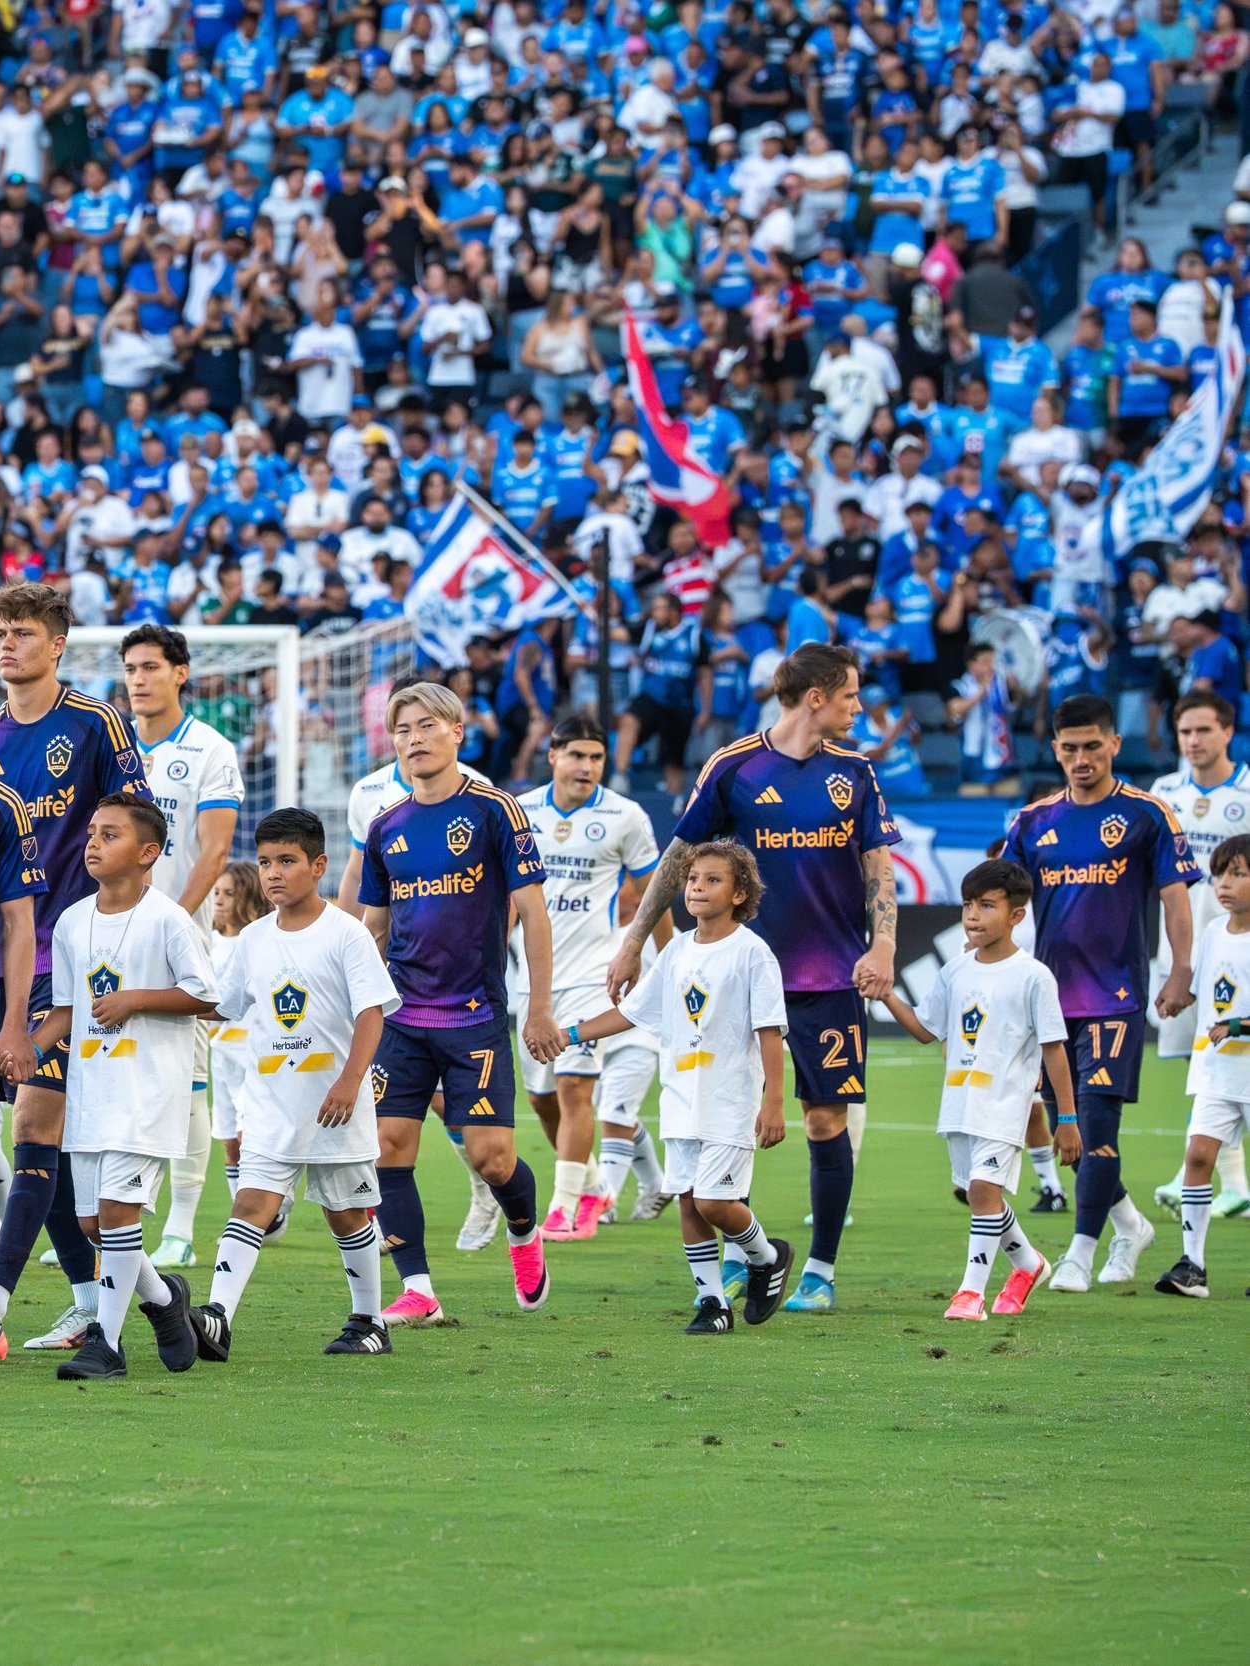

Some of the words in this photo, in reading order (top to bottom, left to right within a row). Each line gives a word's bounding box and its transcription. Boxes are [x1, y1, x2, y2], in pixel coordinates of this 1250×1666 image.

[51, 755, 66, 765] LA
[26, 795, 66, 818] alife
[452, 834, 466, 844] LA
[755, 827, 848, 849] Herbalife
[544, 855, 596, 868] CEMENTO
[569, 870, 593, 880] AZUL
[1040, 863, 1118, 887] Herbalife
[391, 873, 475, 901] Herbalife
[95, 981, 113, 995] LA
[1215, 987, 1230, 1001] LA
[279, 998, 300, 1012] LA
[272, 1040, 309, 1051] Herbalife
[819, 1024, 863, 1069] 21
[1088, 1020, 1128, 1060] 17
[470, 1049, 494, 1089] 7
